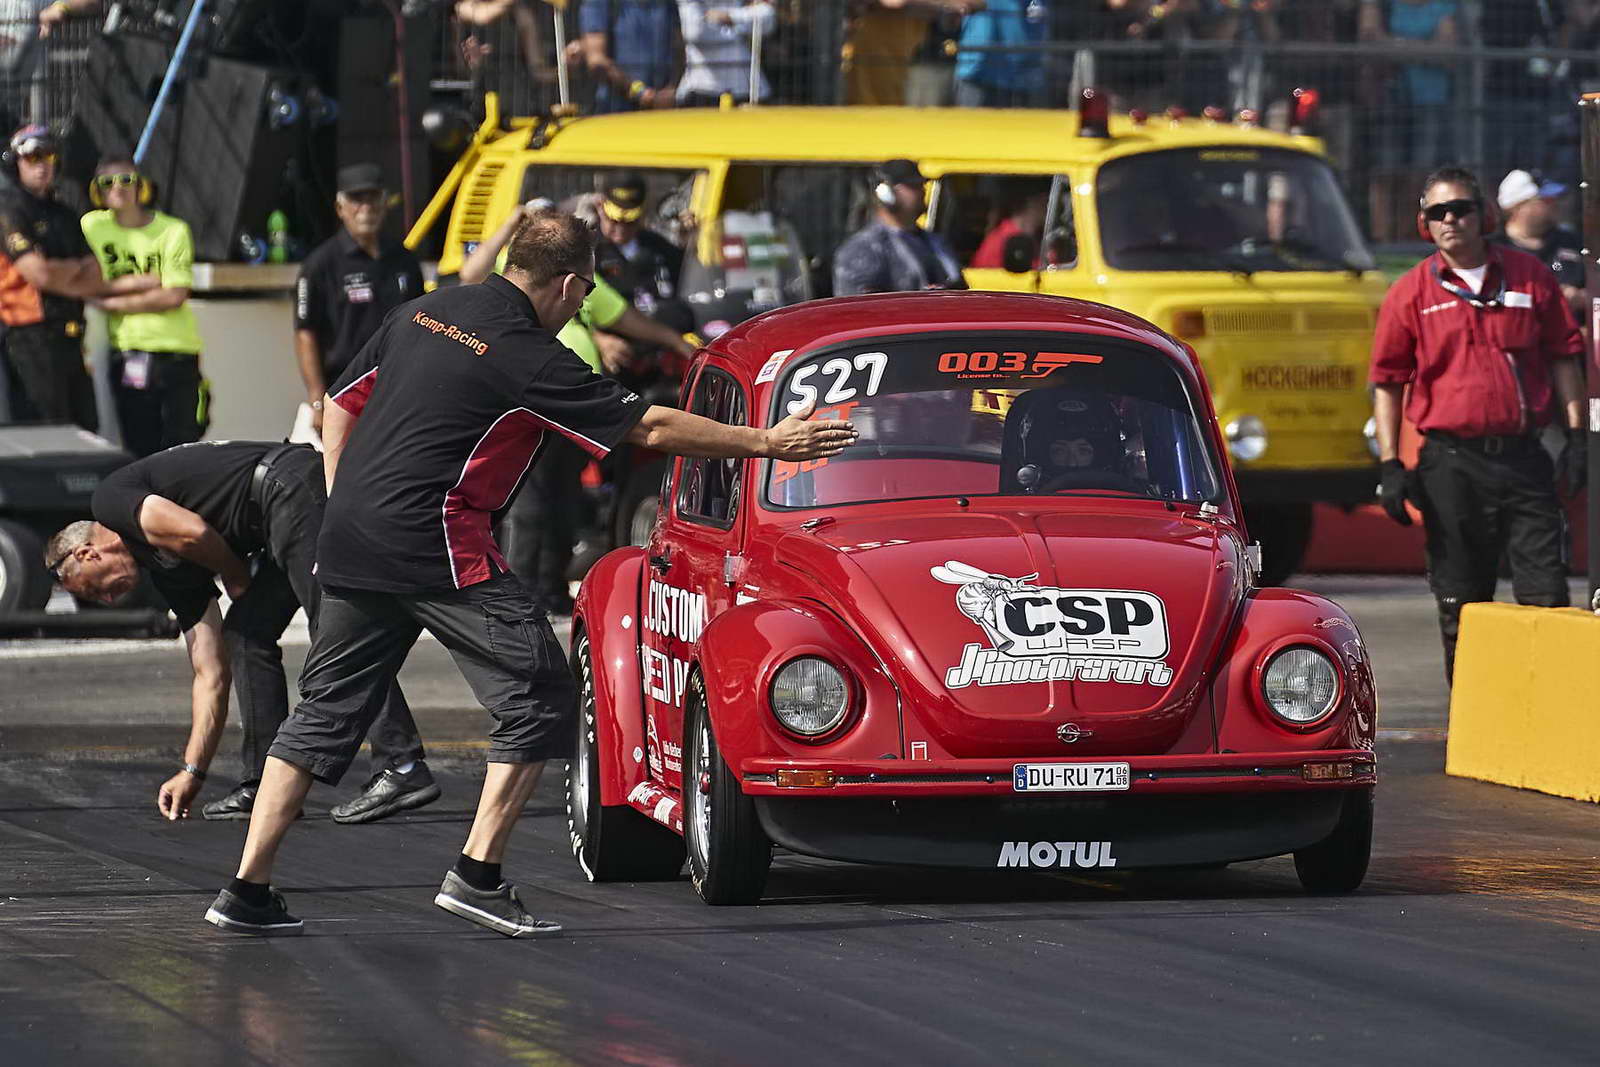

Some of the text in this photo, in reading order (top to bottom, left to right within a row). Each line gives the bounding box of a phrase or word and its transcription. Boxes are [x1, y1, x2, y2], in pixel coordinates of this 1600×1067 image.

[412, 311, 489, 356] Kemp-Racing
[938, 352, 1028, 373] 003
[1004, 596, 1154, 636] CSP
[1025, 637, 1141, 651] WASP
[1029, 768, 1116, 787] DU-RU 71
[996, 841, 1117, 868] MOTUL
